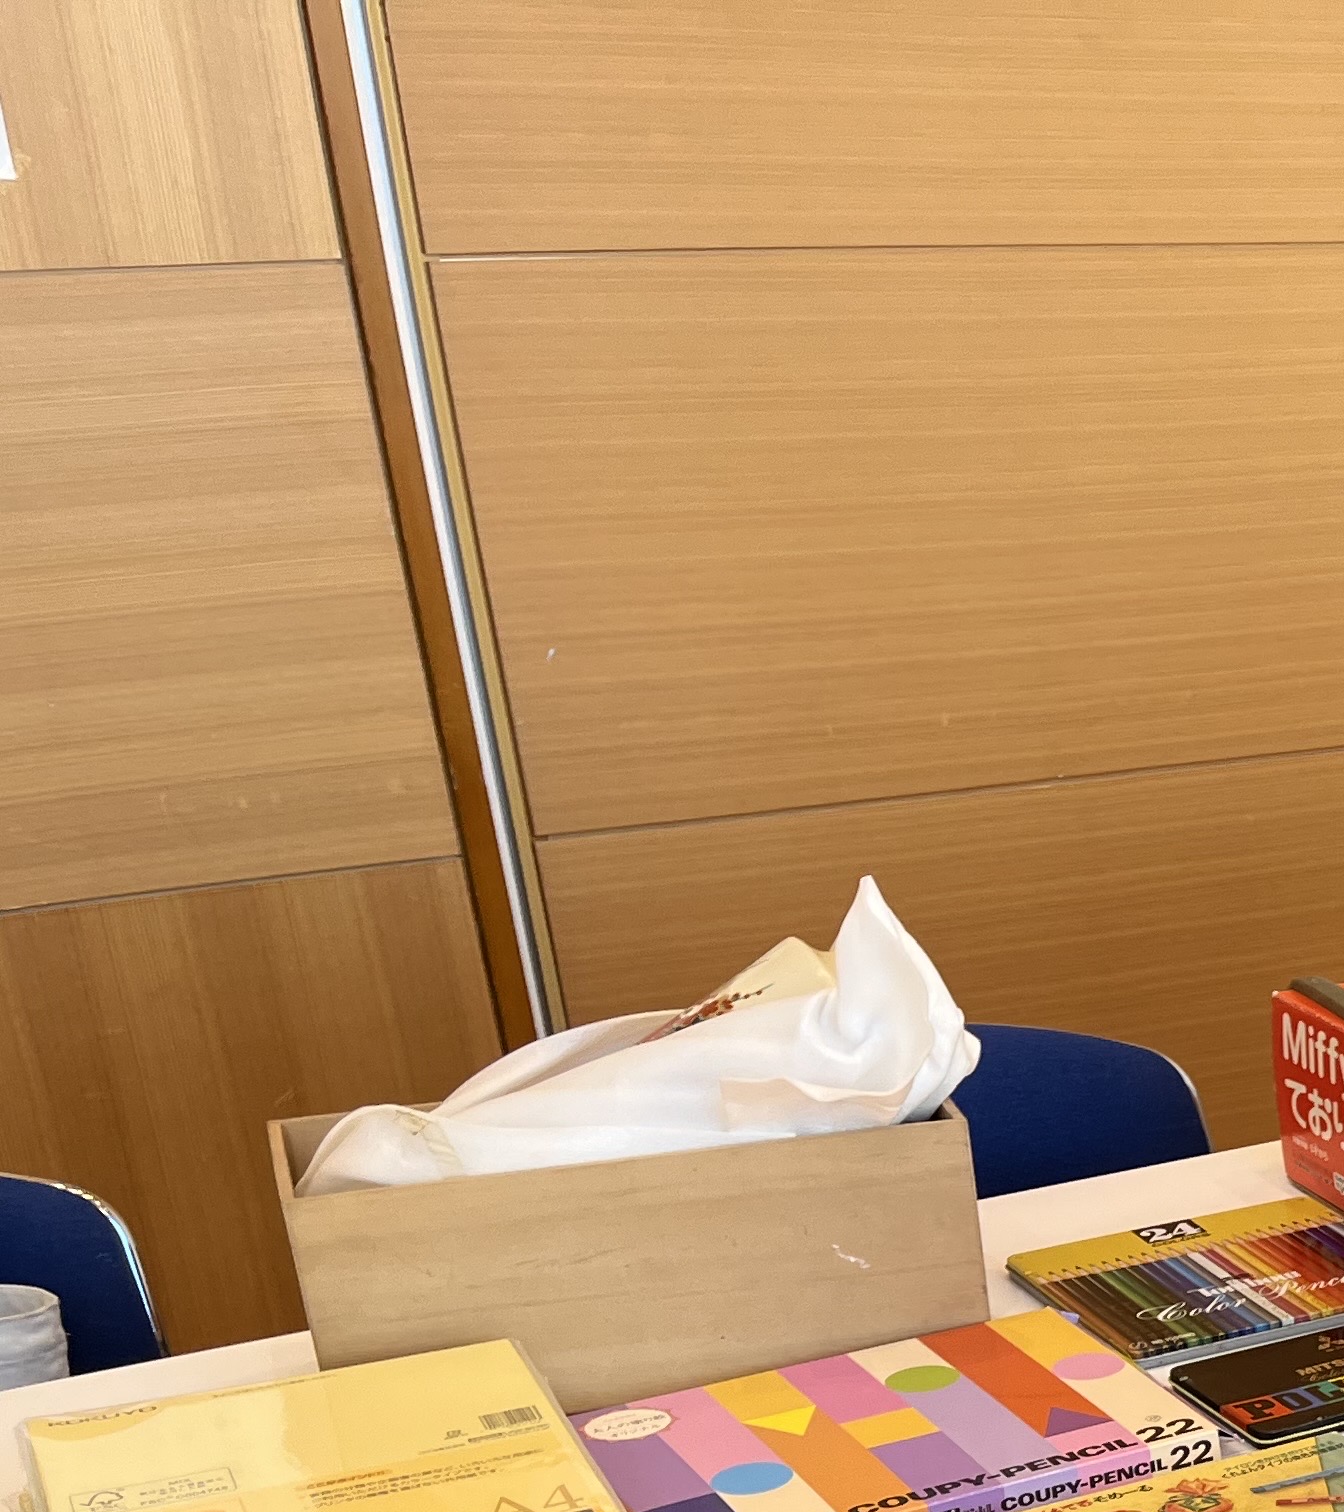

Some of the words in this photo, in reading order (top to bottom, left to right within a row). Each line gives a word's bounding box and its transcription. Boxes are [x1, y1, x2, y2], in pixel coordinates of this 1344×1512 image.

[1139, 1221, 1202, 1244] 24
[1135, 1293, 1248, 1324] Color
[47, 1405, 158, 1428] KOKUYO
[1134, 1418, 1204, 1444] 22
[1169, 1439, 1215, 1472] 22
